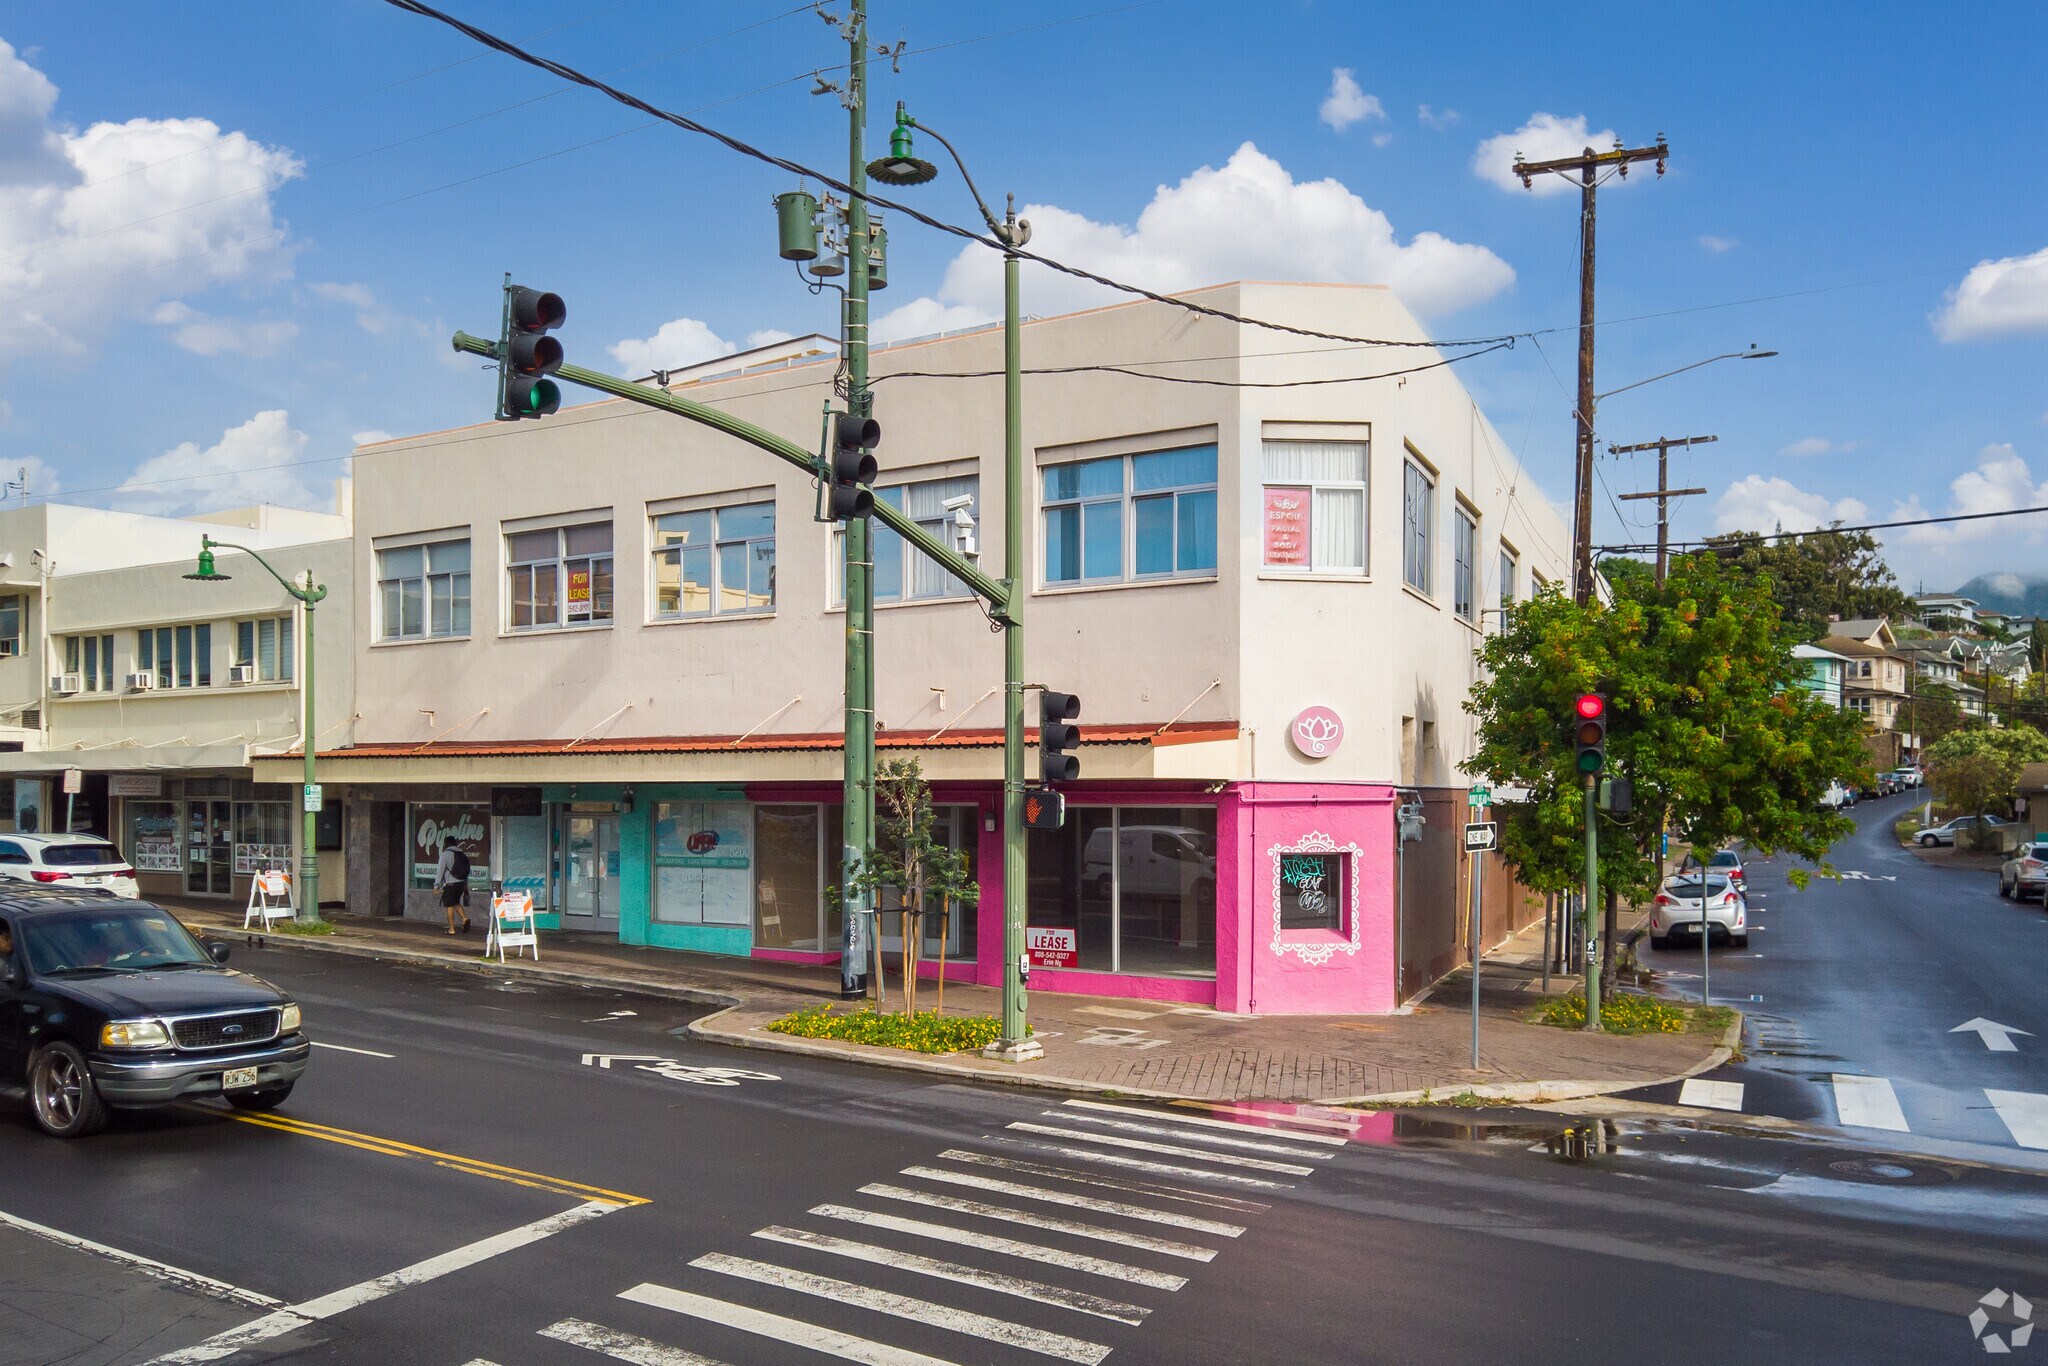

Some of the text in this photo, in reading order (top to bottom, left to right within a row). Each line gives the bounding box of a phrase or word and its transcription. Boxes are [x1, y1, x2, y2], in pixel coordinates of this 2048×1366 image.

[572, 573, 587, 584] FOR
[569, 588, 590, 600] LEASE
[417, 814, 485, 858] Pipeline
[1469, 832, 1478, 842] ONE
[1034, 936, 1068, 949] LEASE
[1034, 951, 1070, 959] 808-542-0327
[225, 1074, 239, 1085] RJW
[242, 1071, 256, 1083] 256
